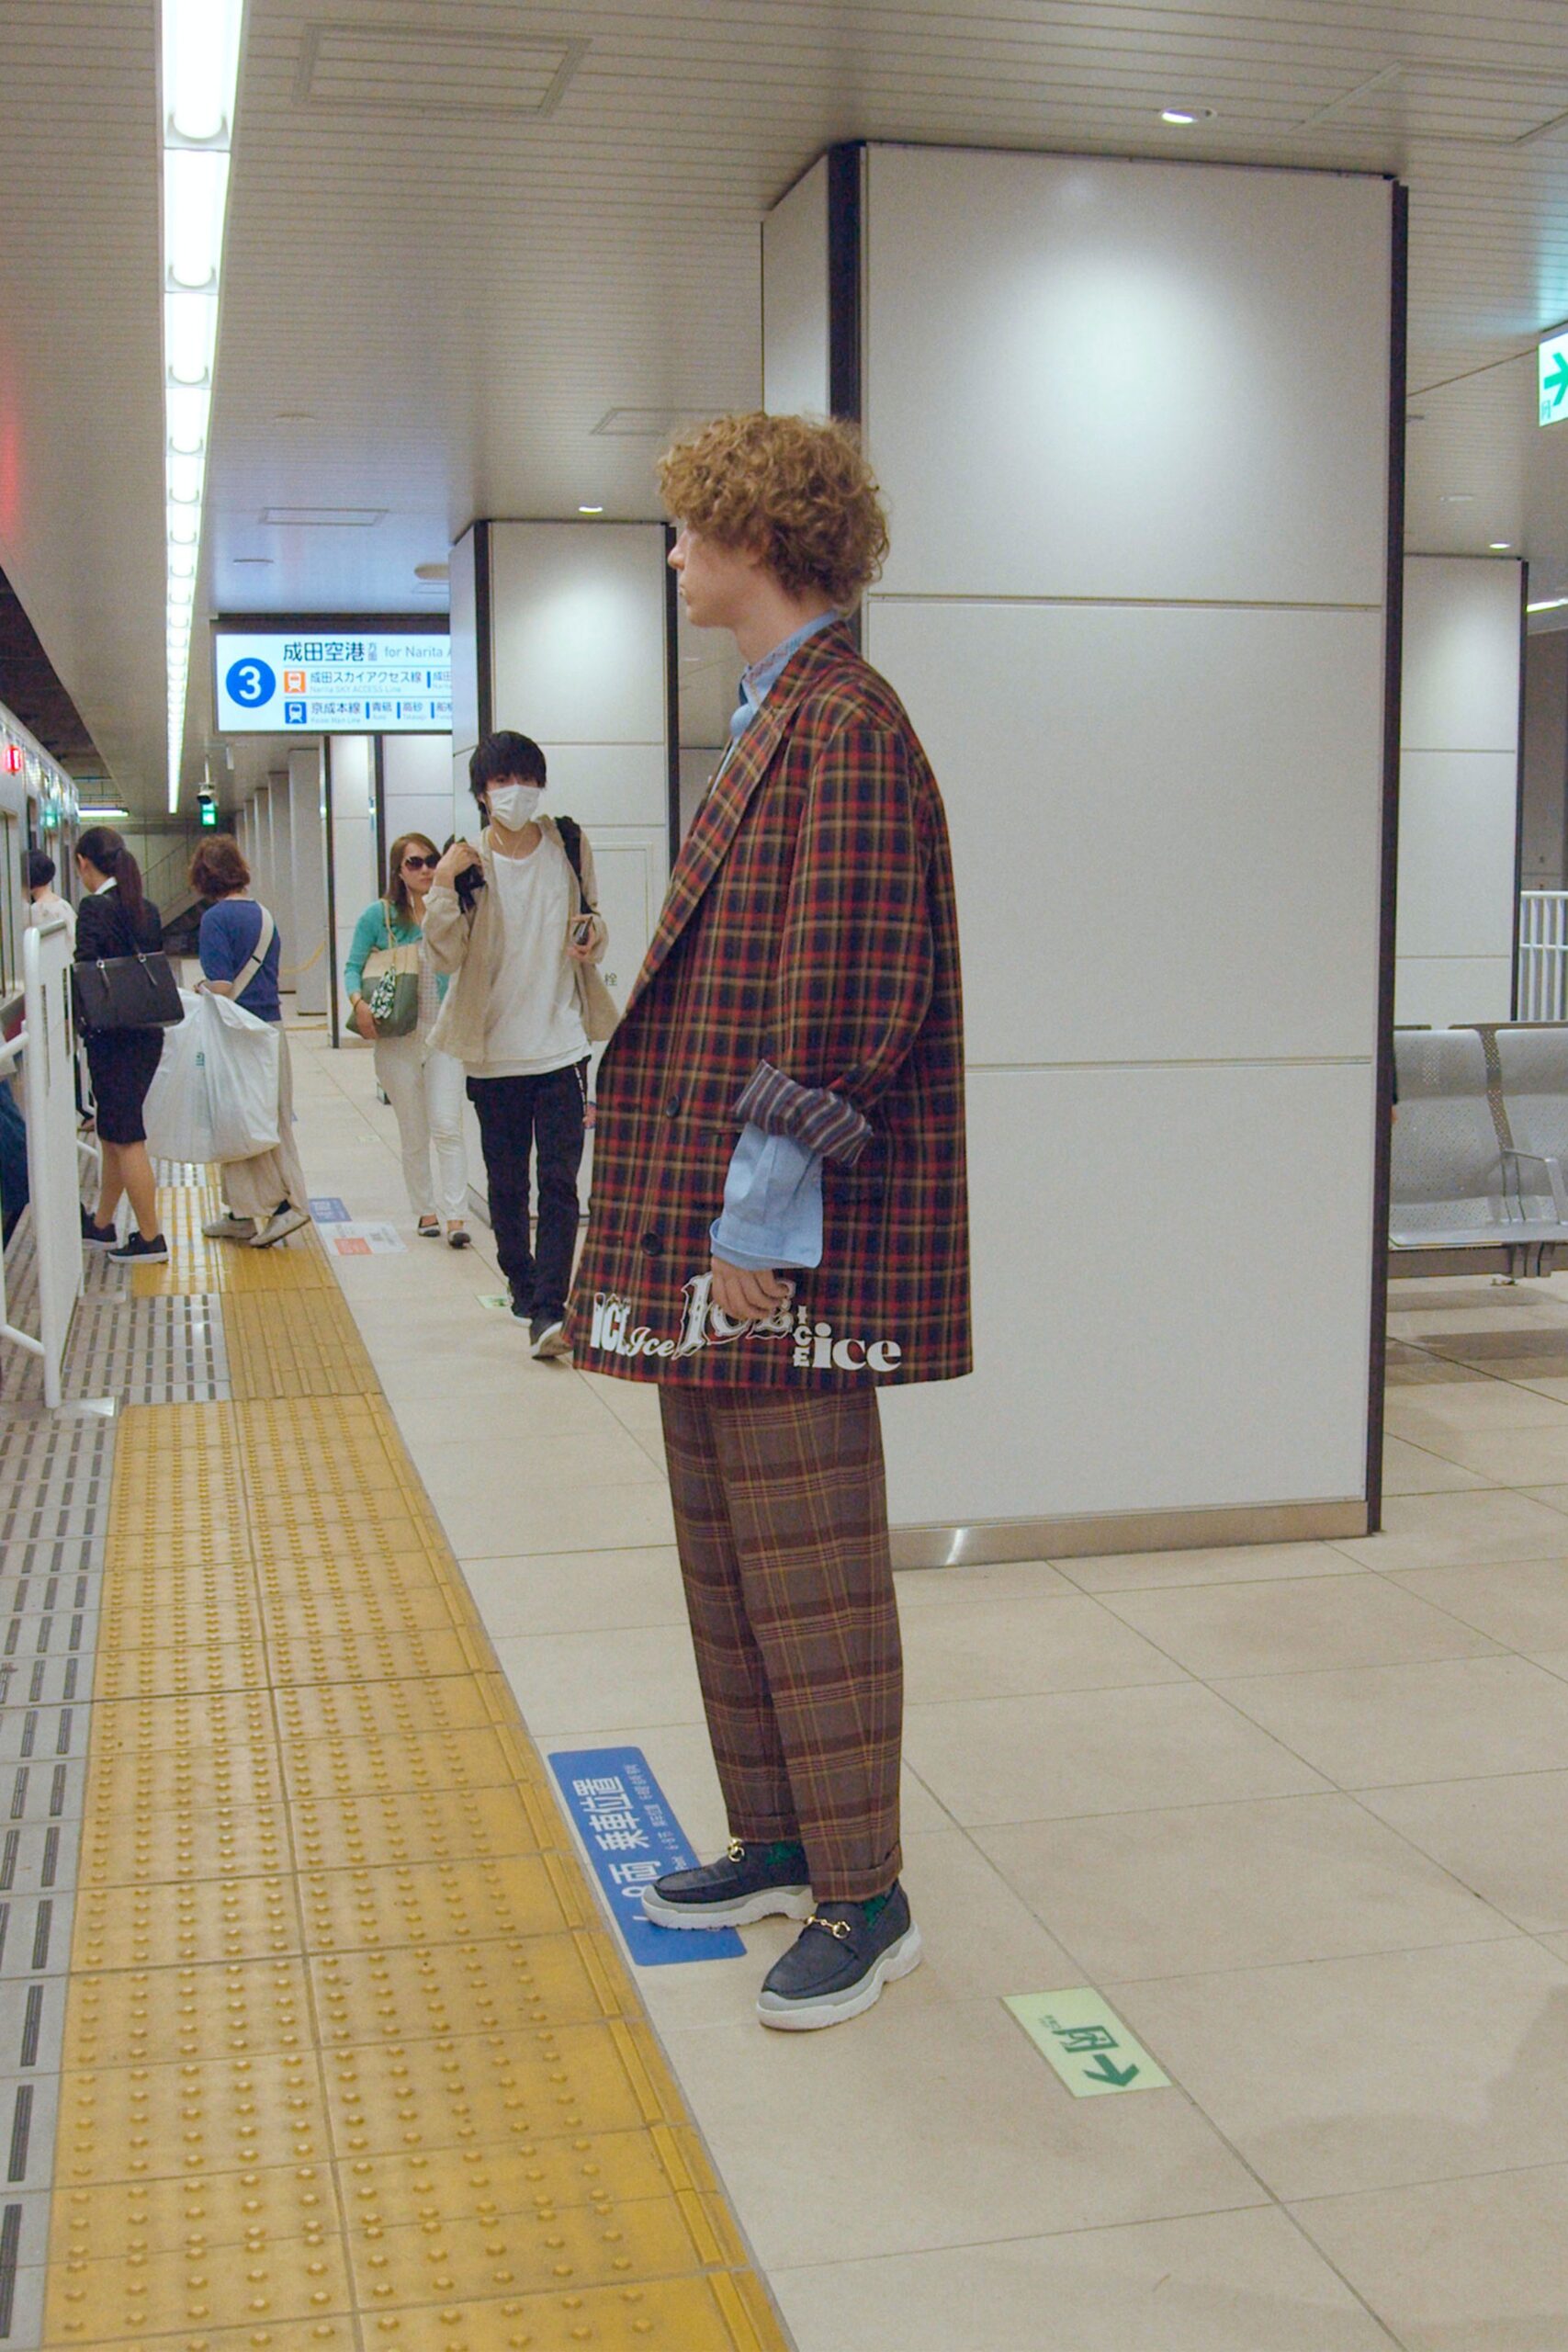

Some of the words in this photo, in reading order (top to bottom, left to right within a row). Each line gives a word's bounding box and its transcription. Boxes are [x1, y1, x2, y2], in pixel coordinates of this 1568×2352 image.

[283, 641, 365, 662] 成田空港
[384, 646, 401, 658] for
[405, 646, 443, 658] Narita
[238, 665, 262, 701] 3
[310, 671, 422, 684] 成田スカイアクセス線
[626, 1327, 675, 1357] Ice
[793, 1306, 813, 1367] ICE
[812, 1322, 902, 1373] ice
[572, 1775, 650, 1851] 乗車位置
